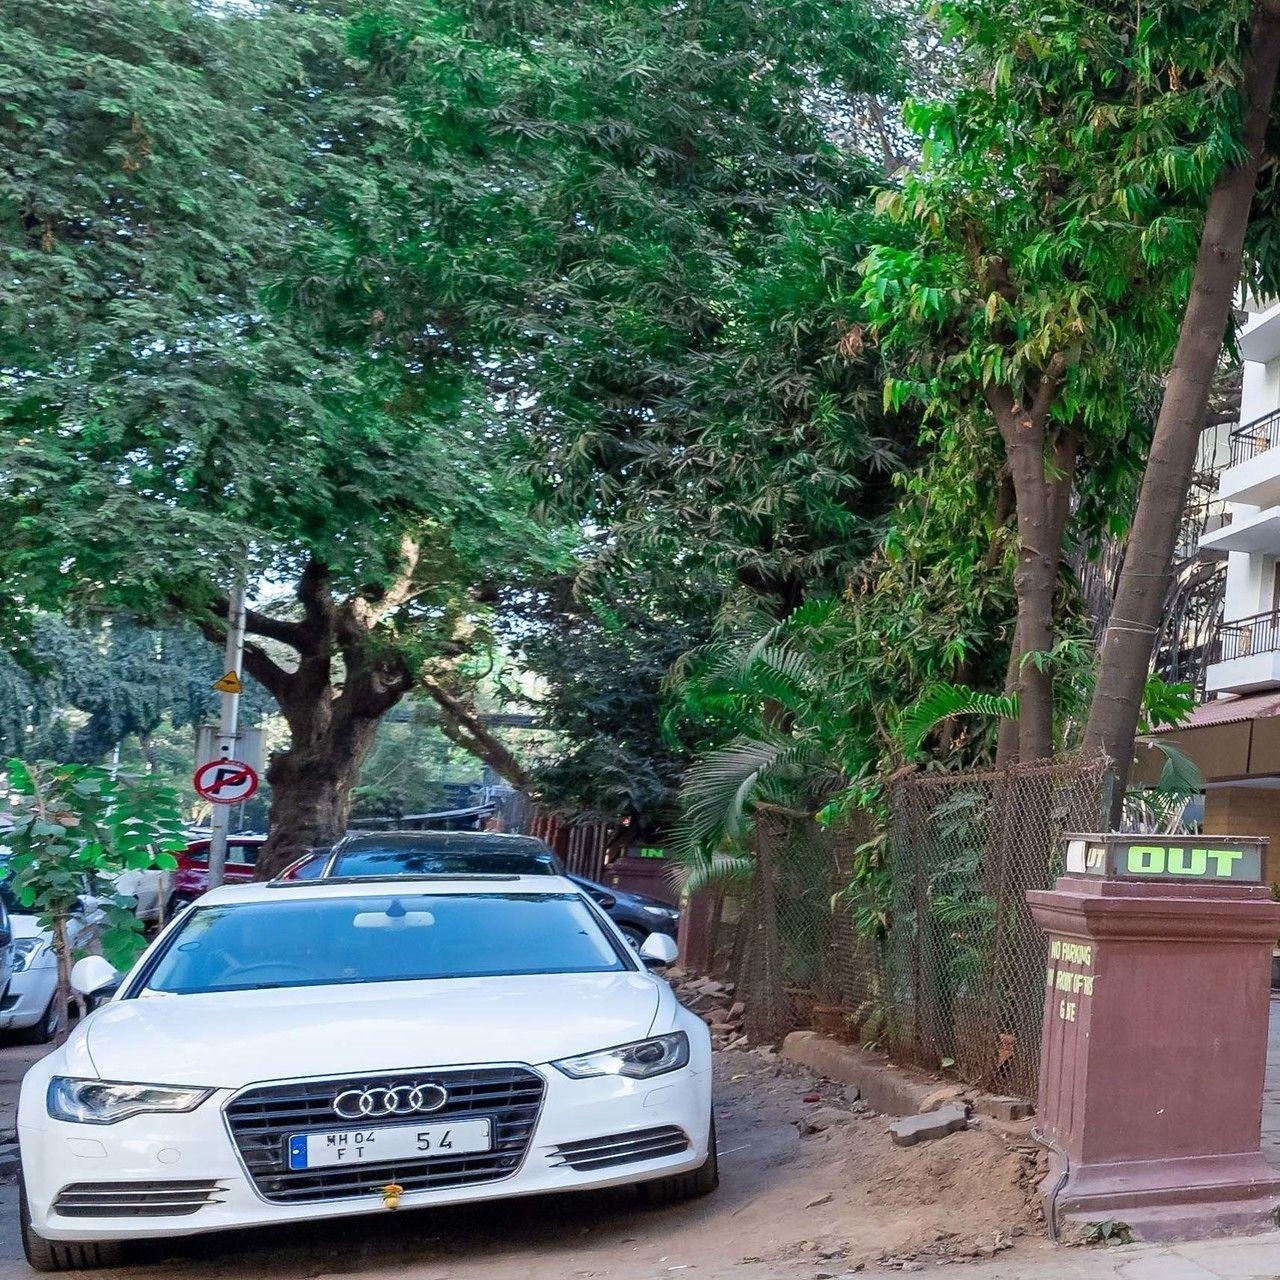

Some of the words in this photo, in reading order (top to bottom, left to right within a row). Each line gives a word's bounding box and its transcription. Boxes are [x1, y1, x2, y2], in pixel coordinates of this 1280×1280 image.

[212, 768, 247, 795] P
[640, 848, 664, 858] IN
[1086, 847, 1106, 868] UT
[1127, 845, 1243, 877] OUT
[1051, 941, 1061, 960] NO
[1062, 942, 1091, 966] PARKING
[416, 1129, 452, 1151] 54
